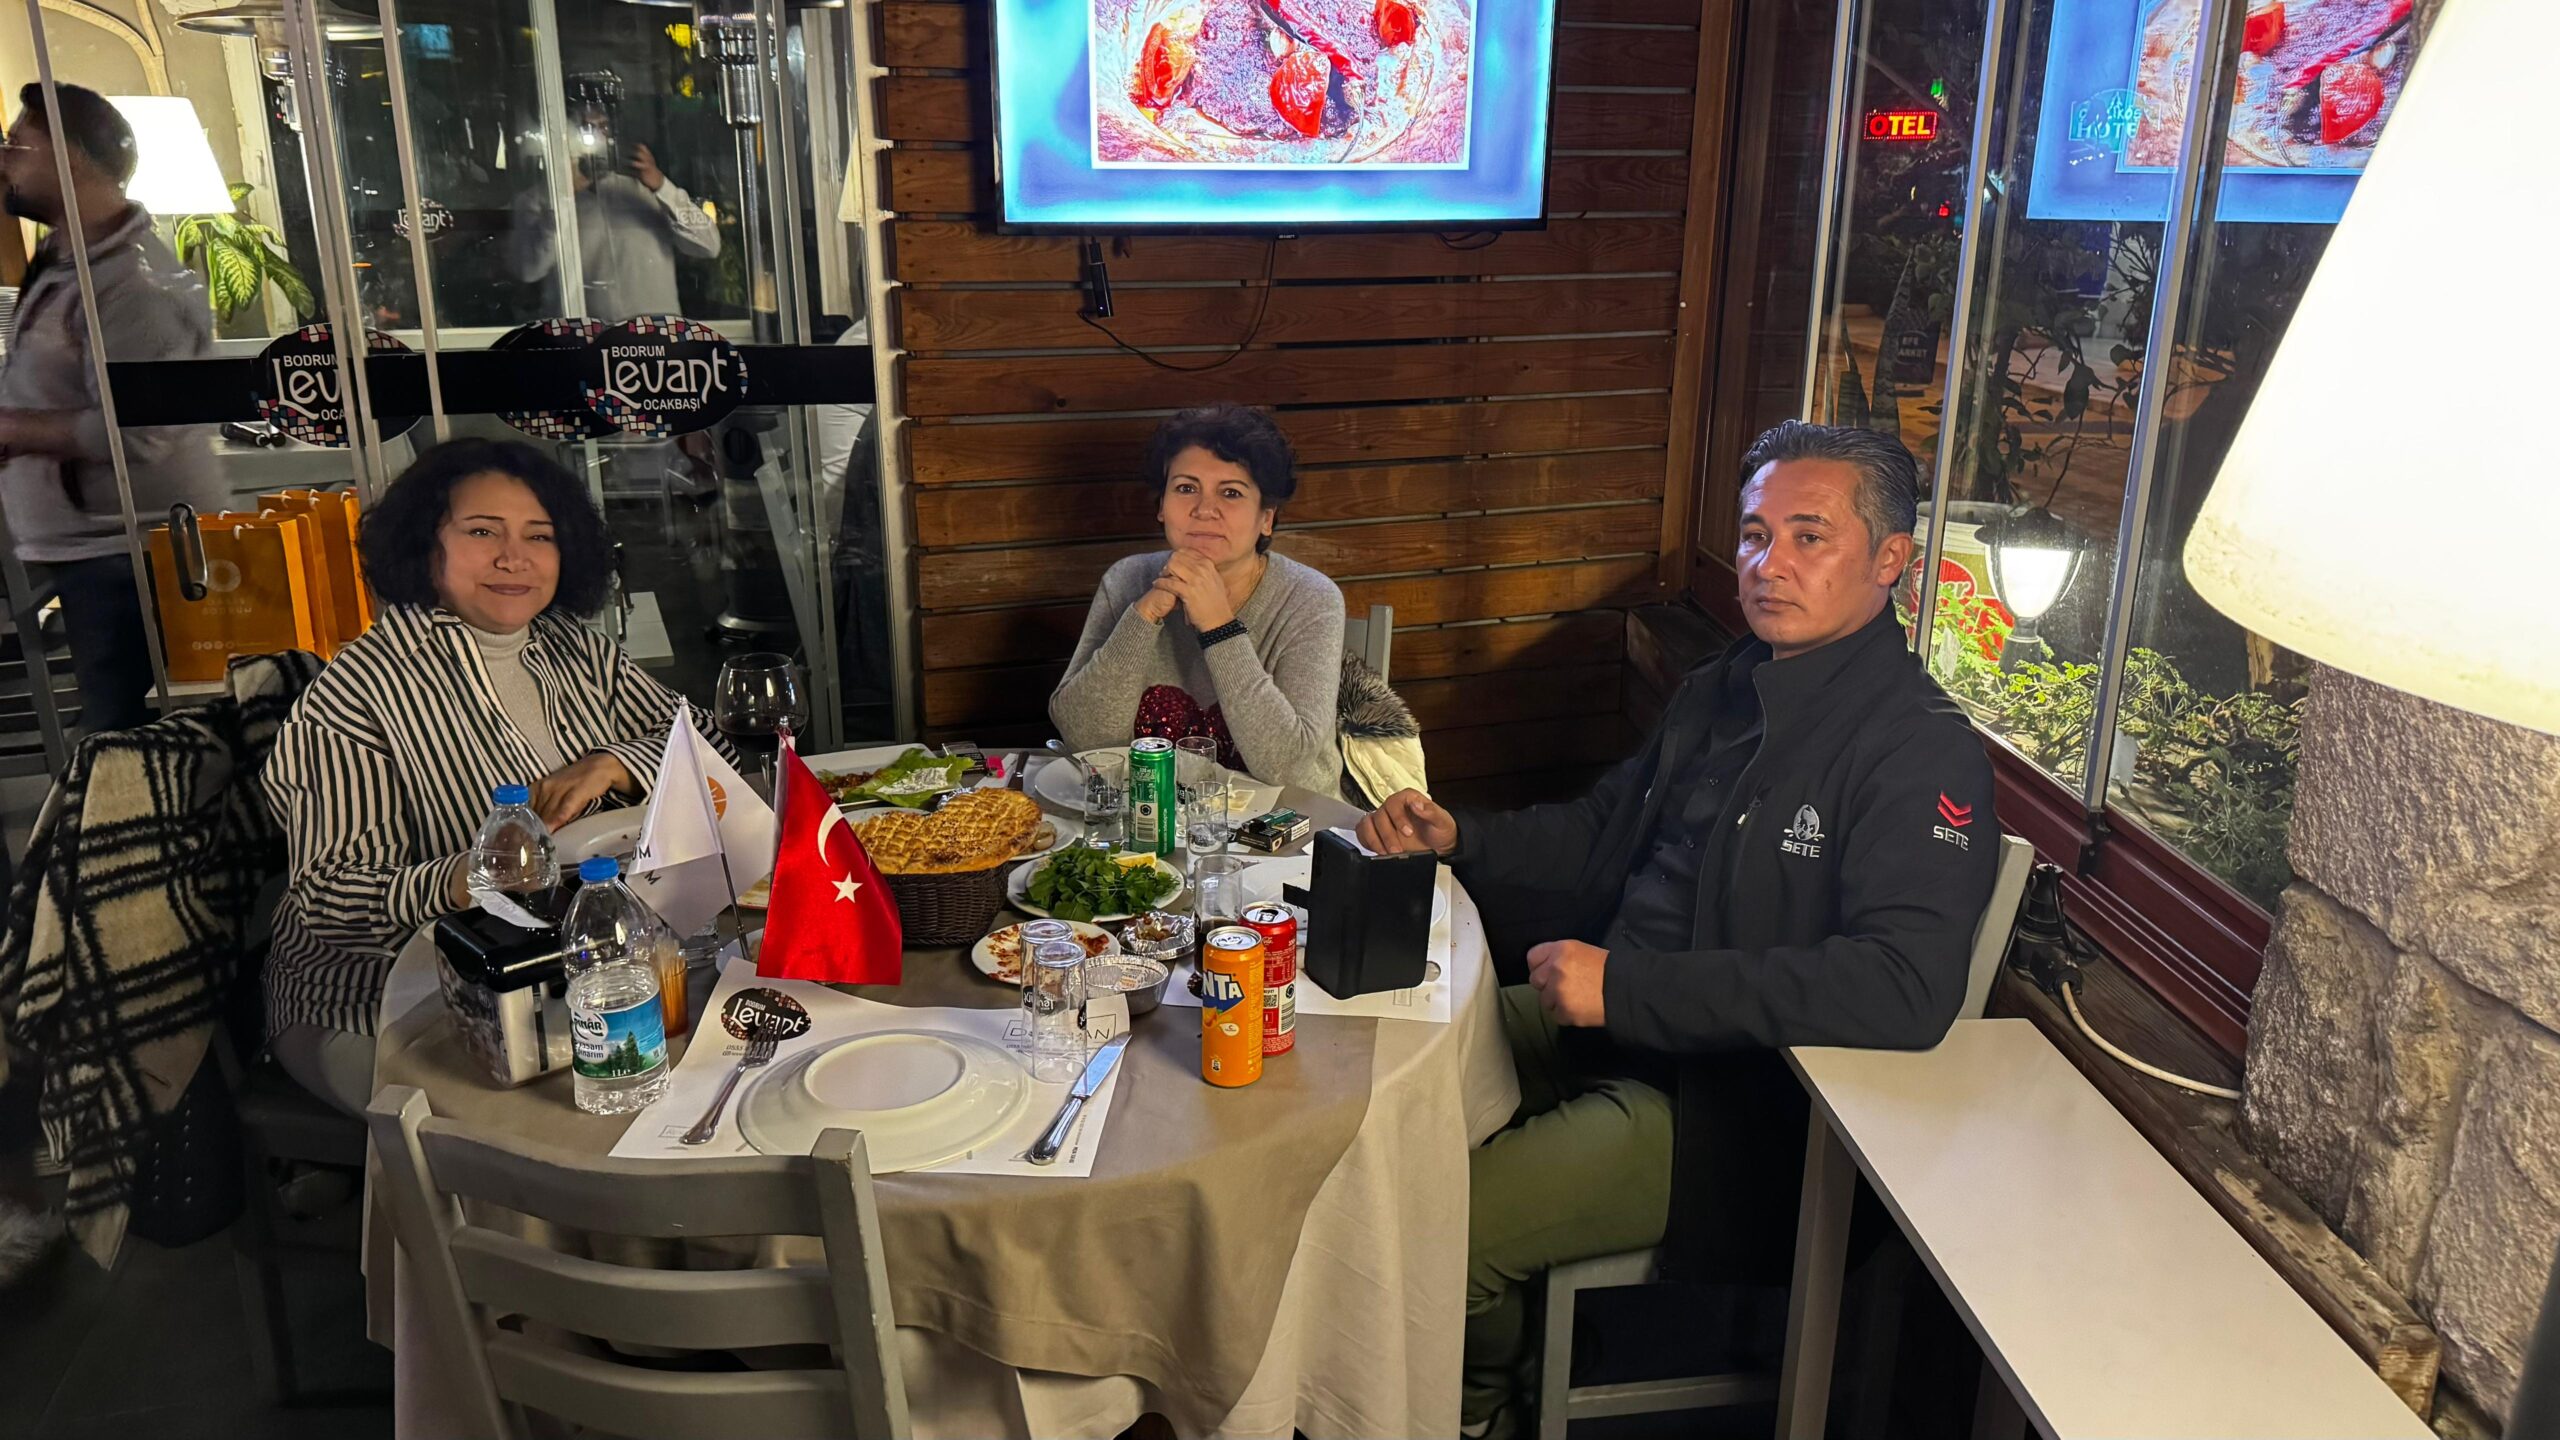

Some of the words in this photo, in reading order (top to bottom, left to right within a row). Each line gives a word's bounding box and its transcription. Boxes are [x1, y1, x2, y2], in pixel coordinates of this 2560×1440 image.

[1869, 115, 1931, 136] OTEL
[2076, 121, 2138, 139] HOTE
[398, 209, 446, 231] Lant
[611, 345, 666, 358] BODRUM
[601, 347, 728, 410] Levant
[643, 398, 701, 412] OCAKBAŞI
[1780, 839, 1822, 858] SETE
[1933, 825, 1969, 851] SETE
[1203, 971, 1242, 1000] NTA
